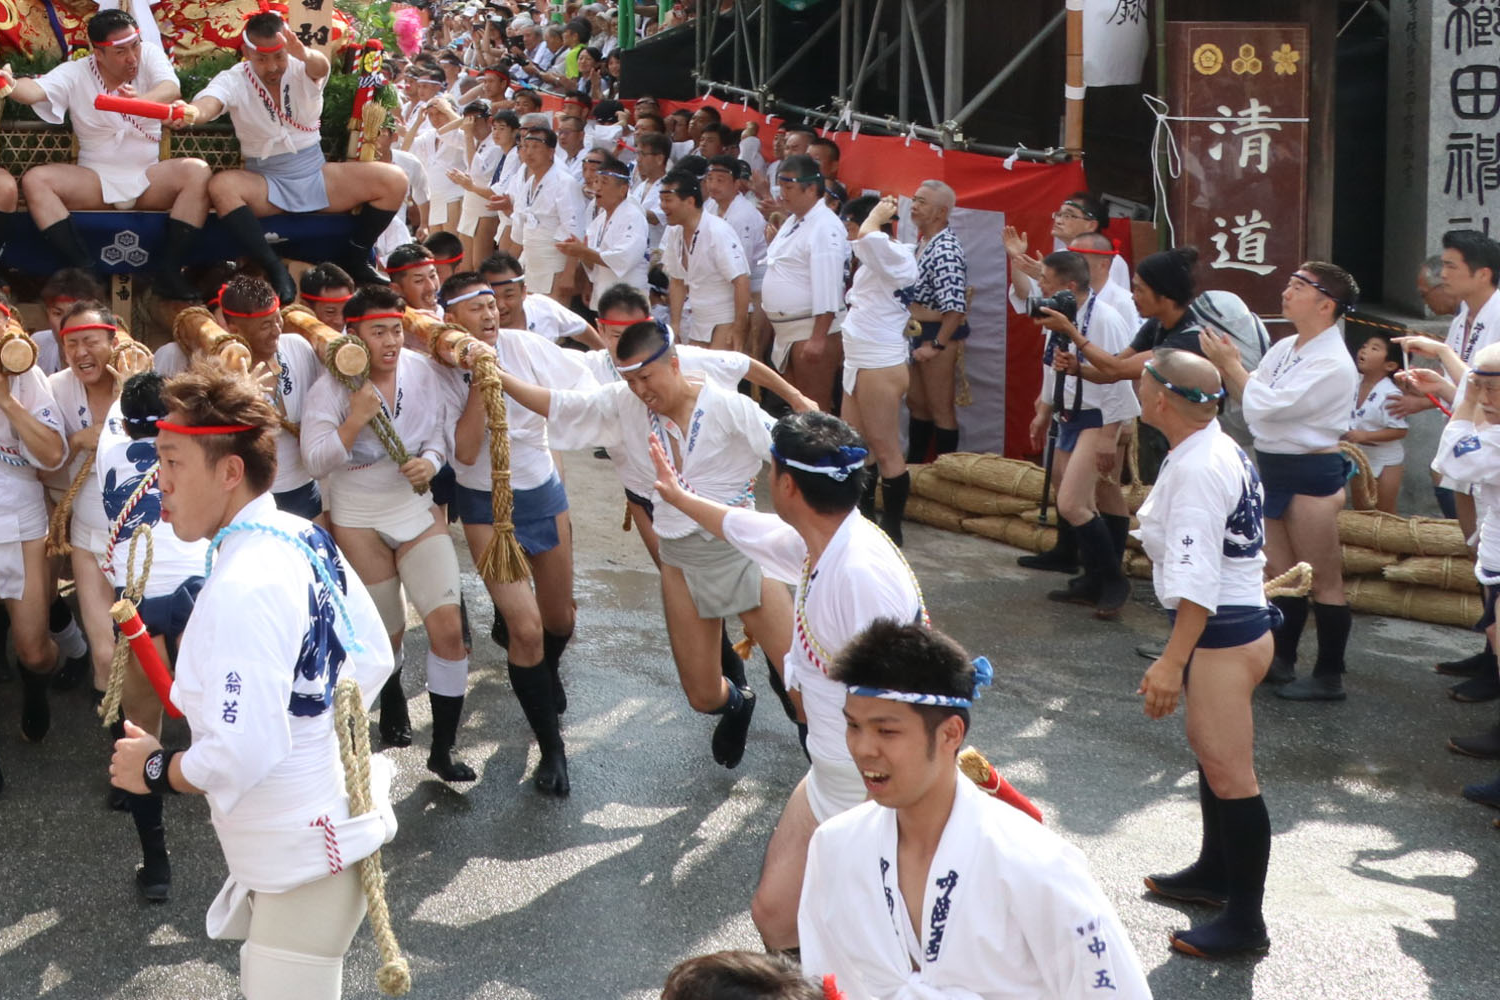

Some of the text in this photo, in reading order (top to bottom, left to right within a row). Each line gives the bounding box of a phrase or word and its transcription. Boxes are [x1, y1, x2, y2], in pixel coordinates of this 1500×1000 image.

[1207, 98, 1283, 277] 清道
[1180, 535, 1195, 567] 中三
[220, 670, 243, 725] 翁若
[1086, 936, 1117, 990] 中五
